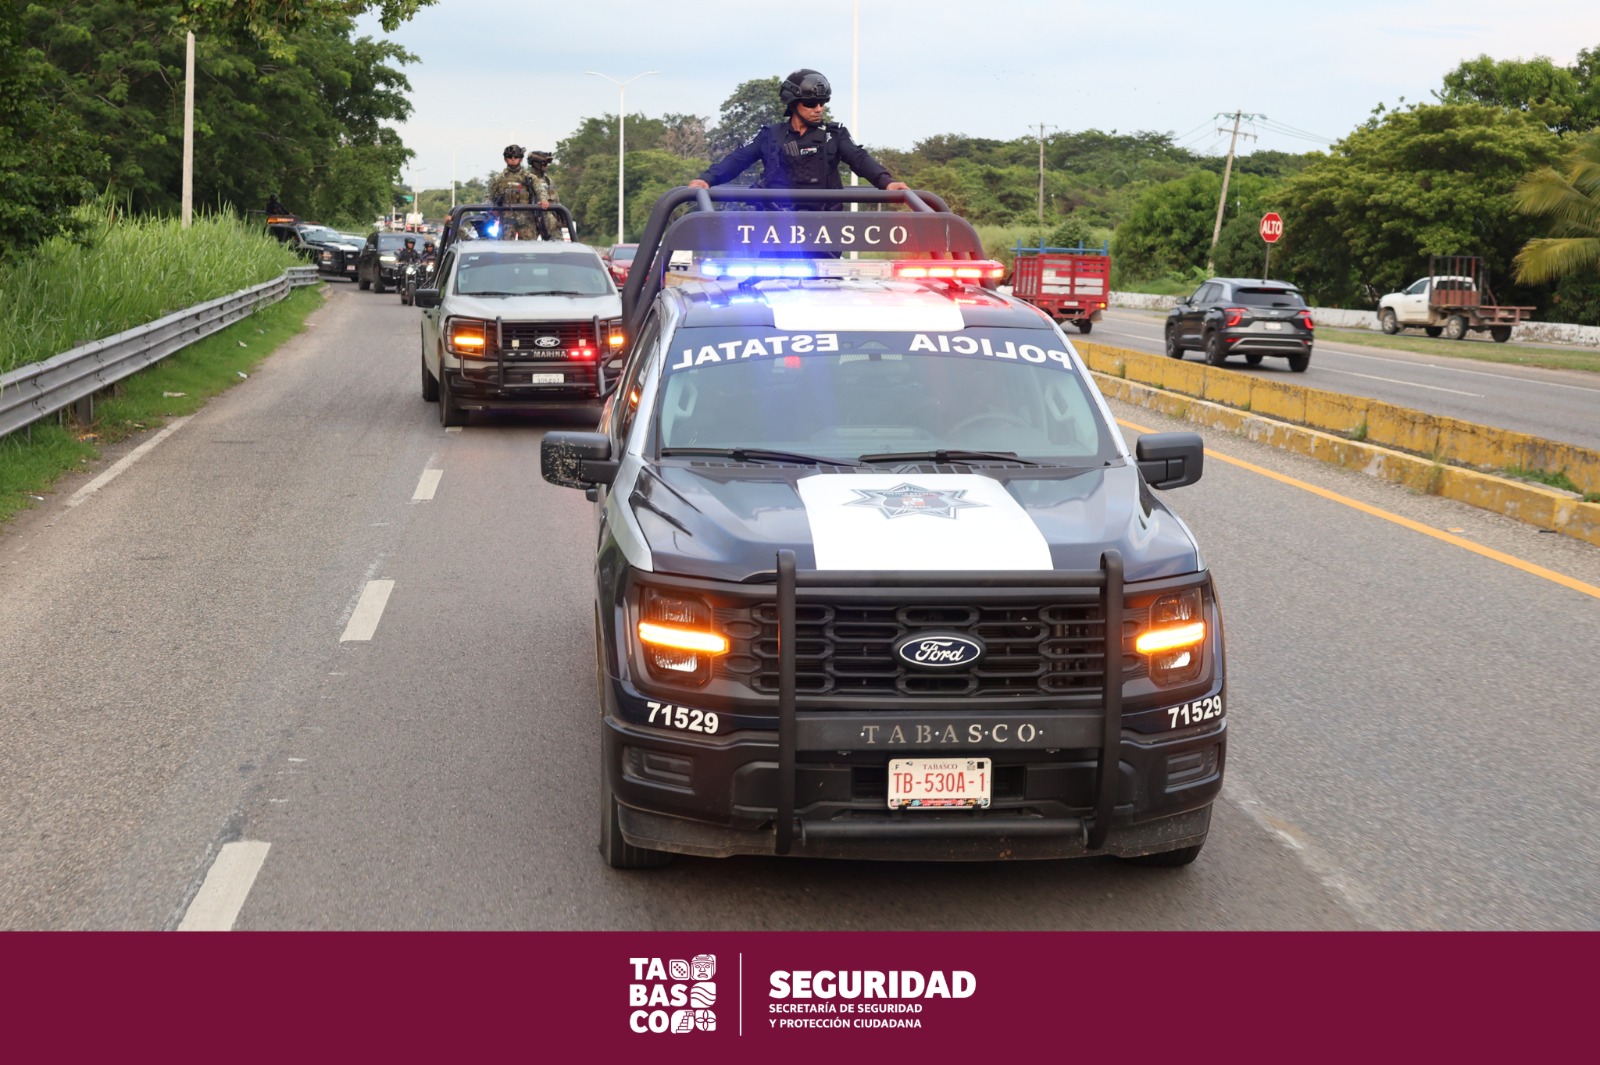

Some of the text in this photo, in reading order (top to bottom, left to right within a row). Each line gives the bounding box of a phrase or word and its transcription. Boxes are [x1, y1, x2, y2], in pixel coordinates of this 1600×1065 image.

[737, 225, 908, 244] TABASCO
[1262, 220, 1282, 235] ALTO
[915, 640, 965, 661] Ford
[647, 701, 719, 734] 71529
[1167, 695, 1222, 729] 71529
[862, 723, 1036, 744] TABASCO
[922, 763, 958, 771] TABASCO
[893, 771, 985, 794] TB-530A-1
